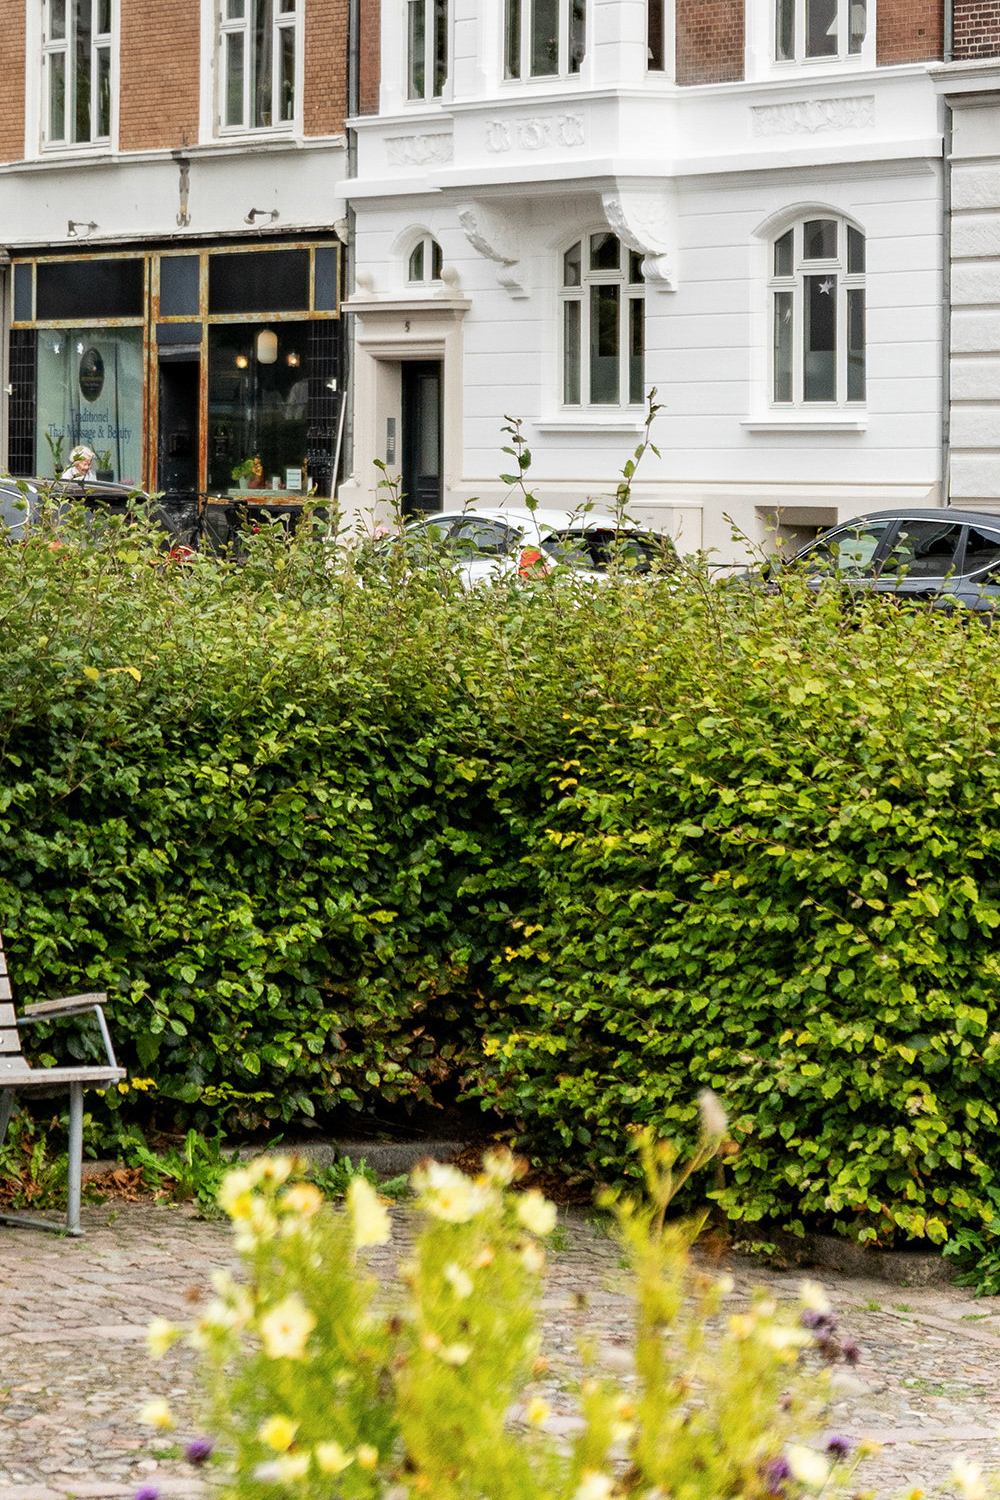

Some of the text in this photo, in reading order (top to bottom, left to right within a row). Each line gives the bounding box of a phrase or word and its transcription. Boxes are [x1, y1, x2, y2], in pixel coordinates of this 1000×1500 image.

[404, 321, 410, 333] 5
[47, 423, 65, 438] Thai
[97, 425, 105, 439] &
[107, 424, 132, 444] Beauty
